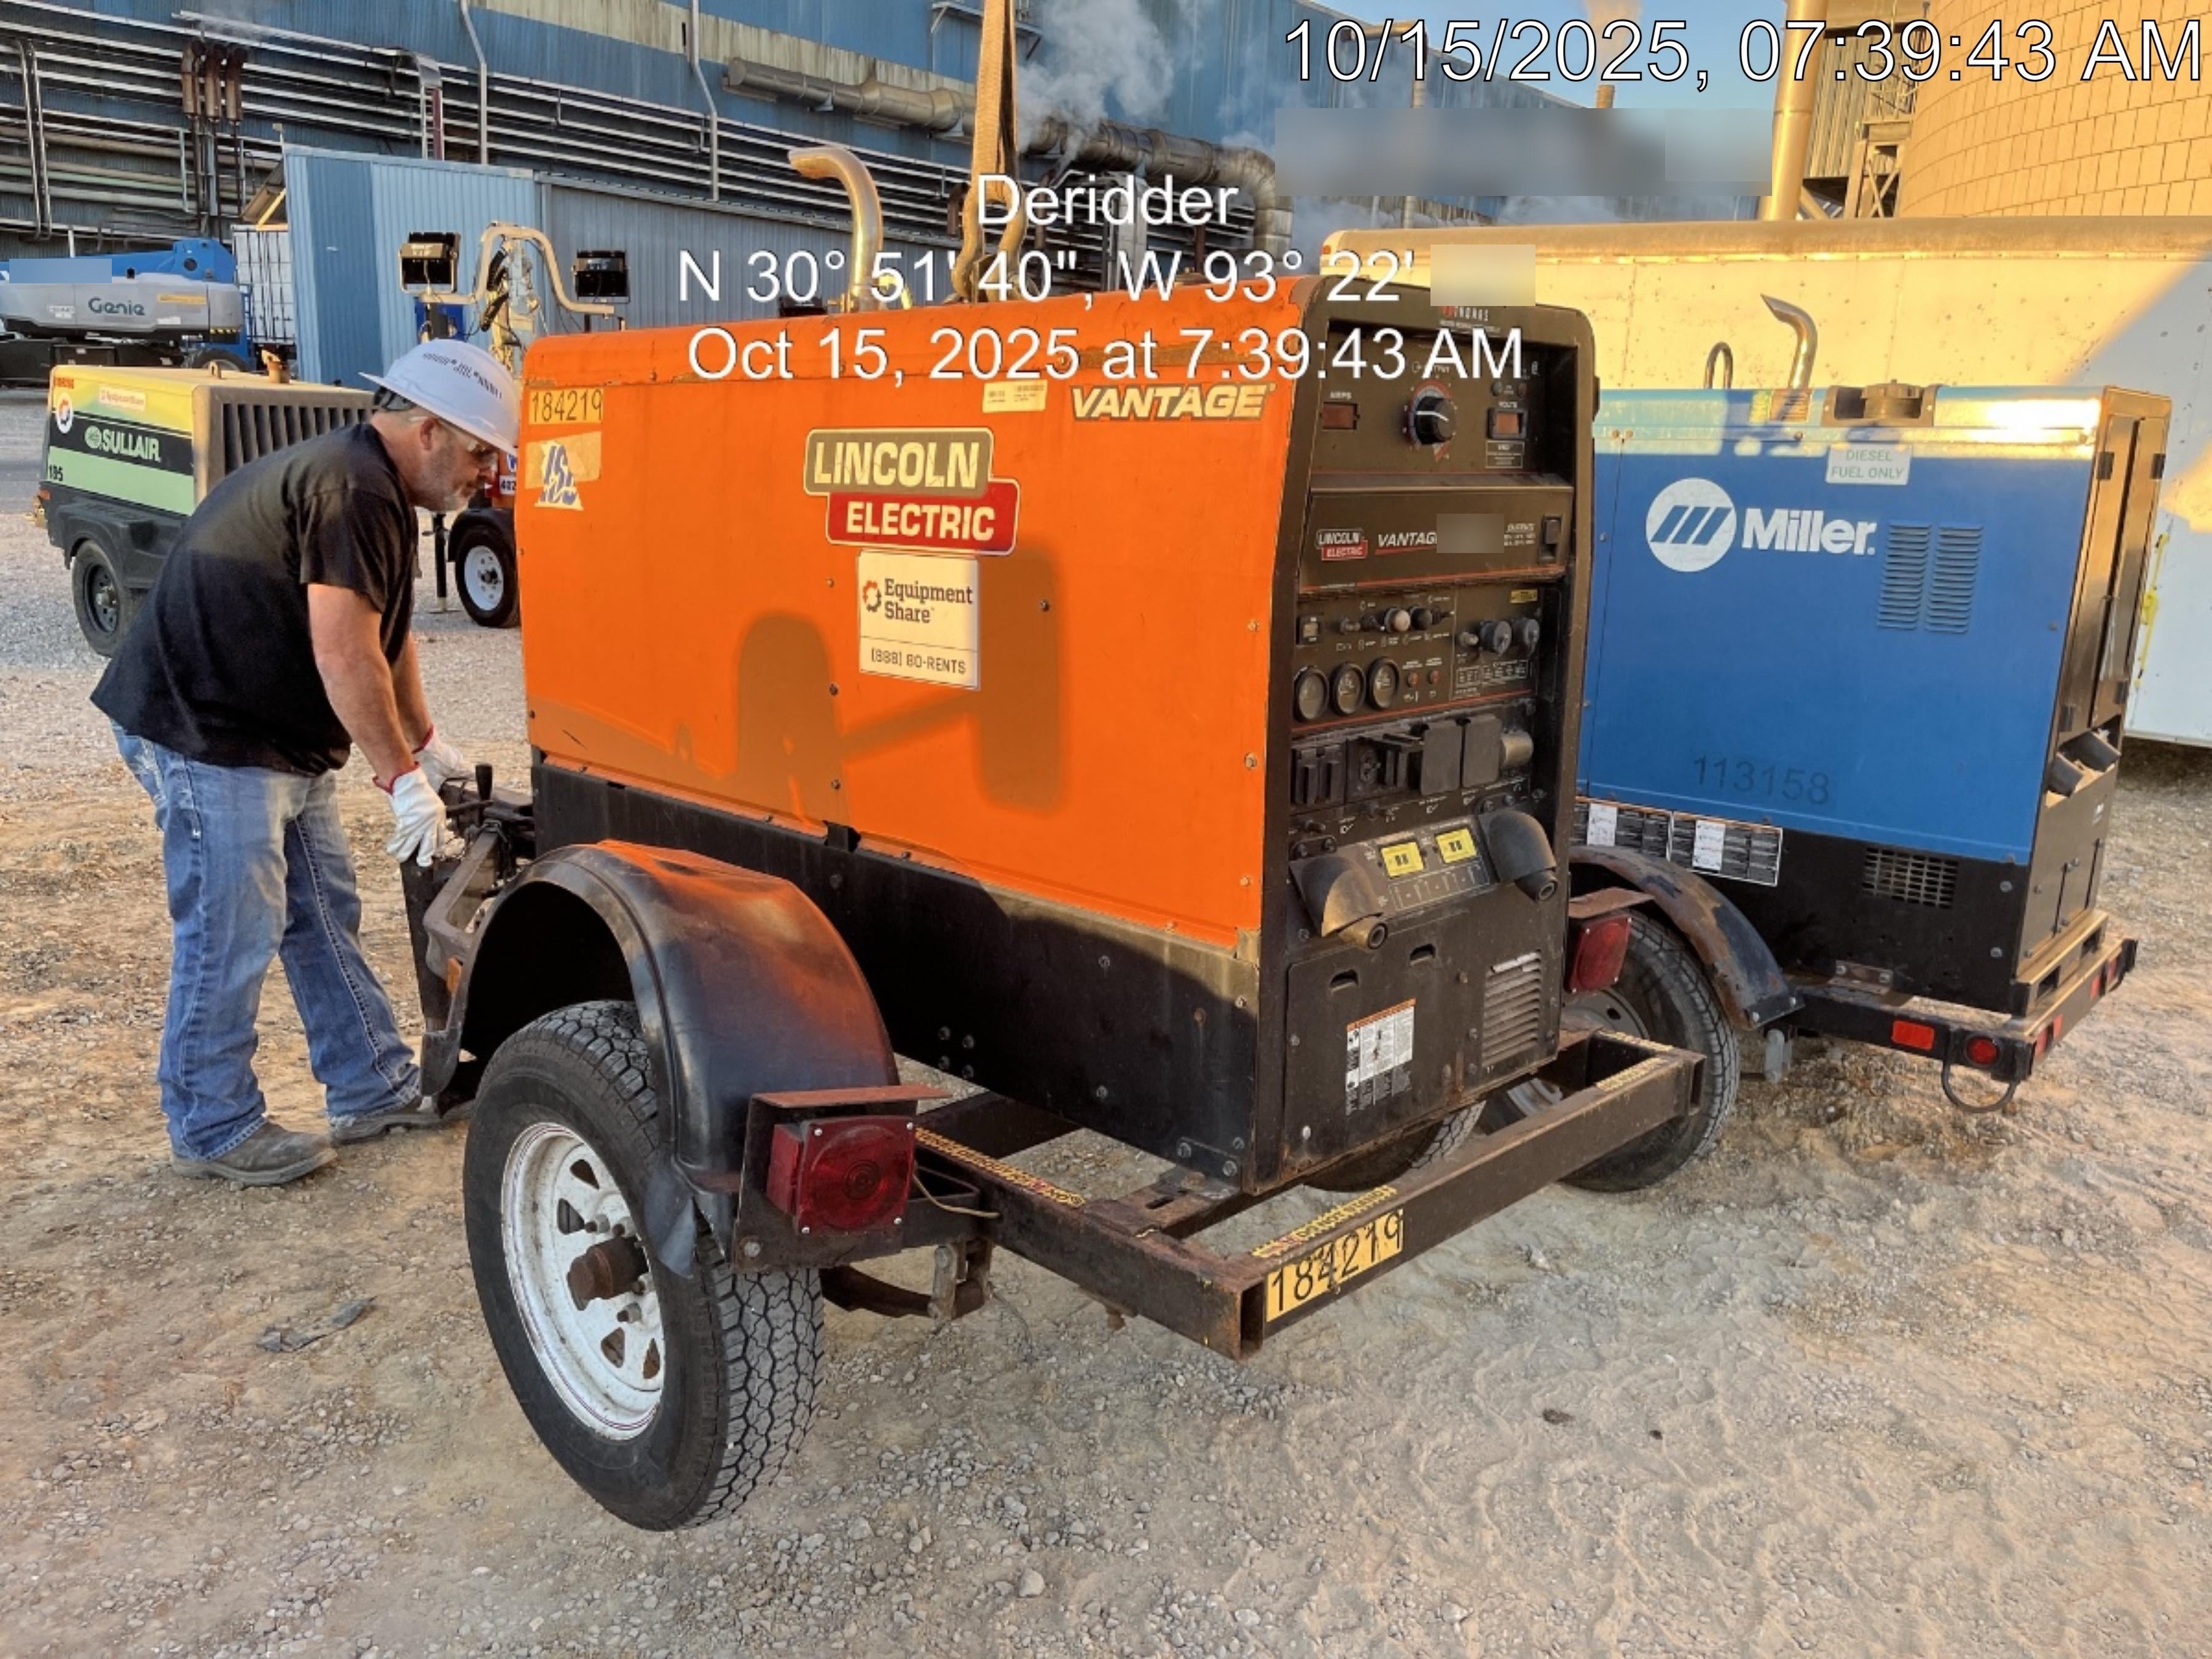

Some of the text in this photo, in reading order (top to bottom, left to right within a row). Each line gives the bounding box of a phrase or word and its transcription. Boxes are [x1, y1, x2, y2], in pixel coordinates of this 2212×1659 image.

[88, 296, 146, 316] Genie
[532, 388, 603, 423] 184219
[1072, 383, 1268, 418] VANTAGE
[102, 428, 161, 462] SULLAIR
[1845, 449, 1894, 462] DIESEL
[814, 441, 980, 489] LINCOLN
[1830, 466, 1905, 479] FUEL ONLY
[845, 501, 997, 542] ELECTRIC
[1319, 531, 1360, 545] LINCOLN
[1326, 547, 1363, 557] ELECTRIC
[884, 578, 974, 605] Equipment
[884, 600, 931, 624] Share
[1693, 753, 1831, 804] 113158
[1271, 1212, 1402, 1312] 184219
